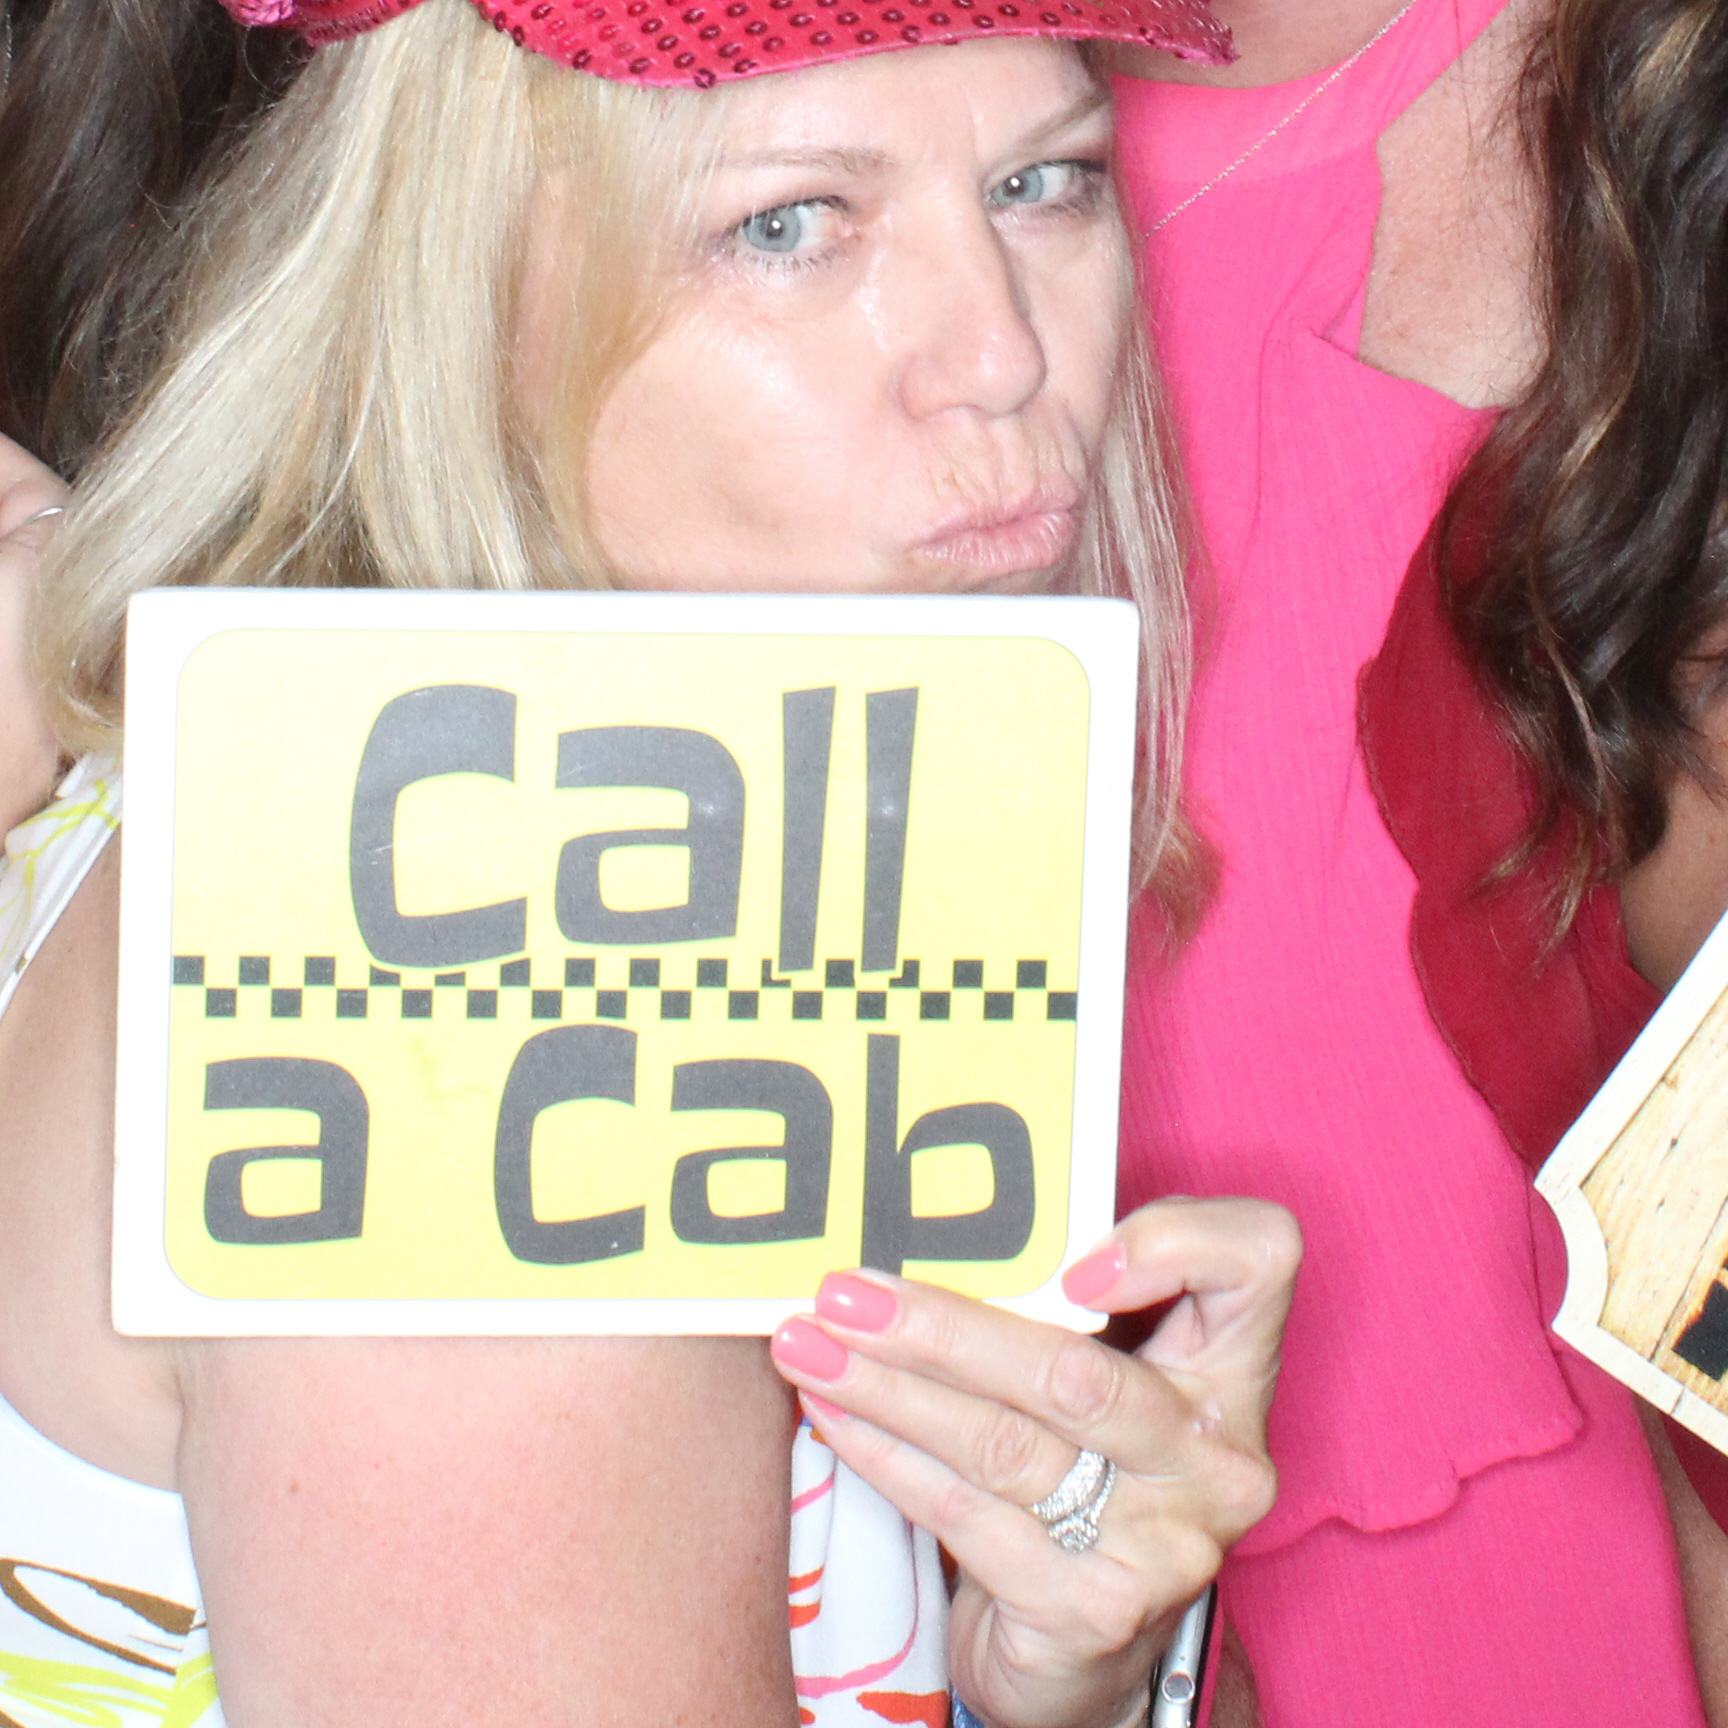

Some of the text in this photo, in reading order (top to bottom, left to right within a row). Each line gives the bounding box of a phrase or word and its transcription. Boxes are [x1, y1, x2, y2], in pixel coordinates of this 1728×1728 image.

[348, 683, 920, 972] Call
[202, 1023, 1035, 1277] a Cab
